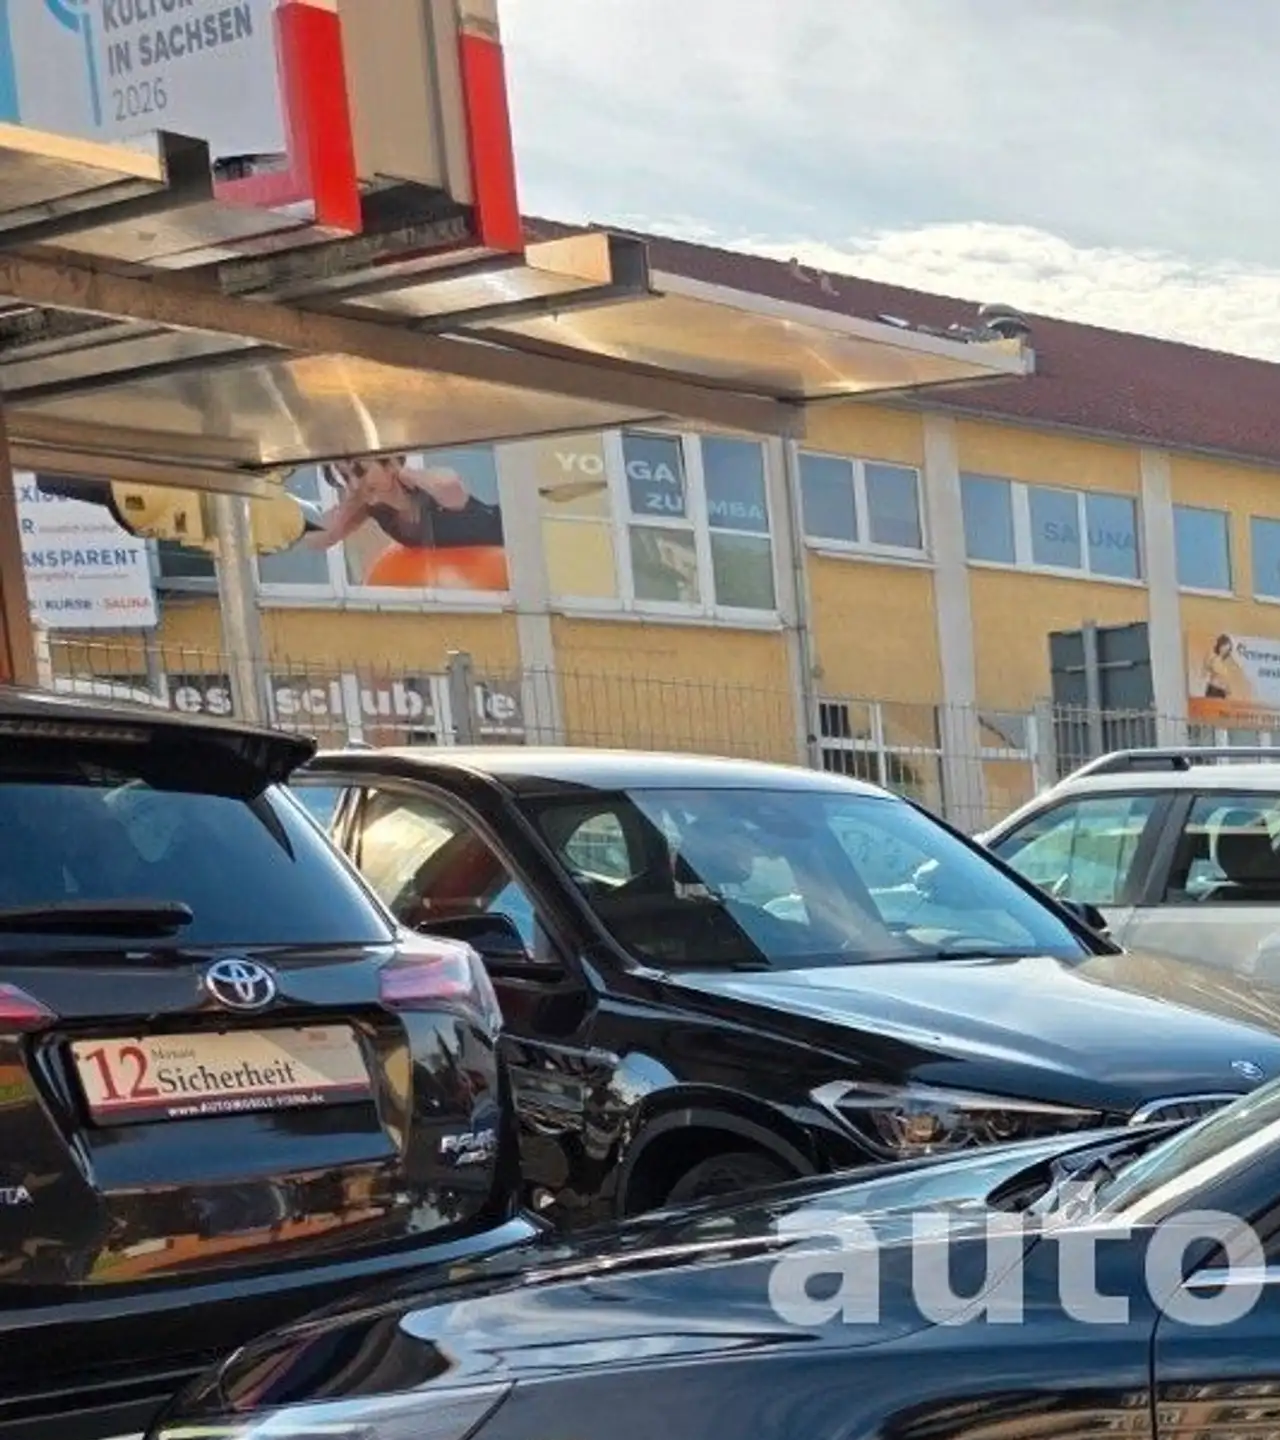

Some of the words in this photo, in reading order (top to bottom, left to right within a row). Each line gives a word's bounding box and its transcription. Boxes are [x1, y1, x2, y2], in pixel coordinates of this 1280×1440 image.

[107, 41, 133, 76] IN
[138, 4, 253, 67] SACHSEN
[112, 76, 168, 122] 2026
[555, 452, 677, 485] YOGA
[645, 493, 764, 521] ZUMBA
[86, 1046, 159, 1101] 12
[157, 1059, 297, 1094] Sicherheit
